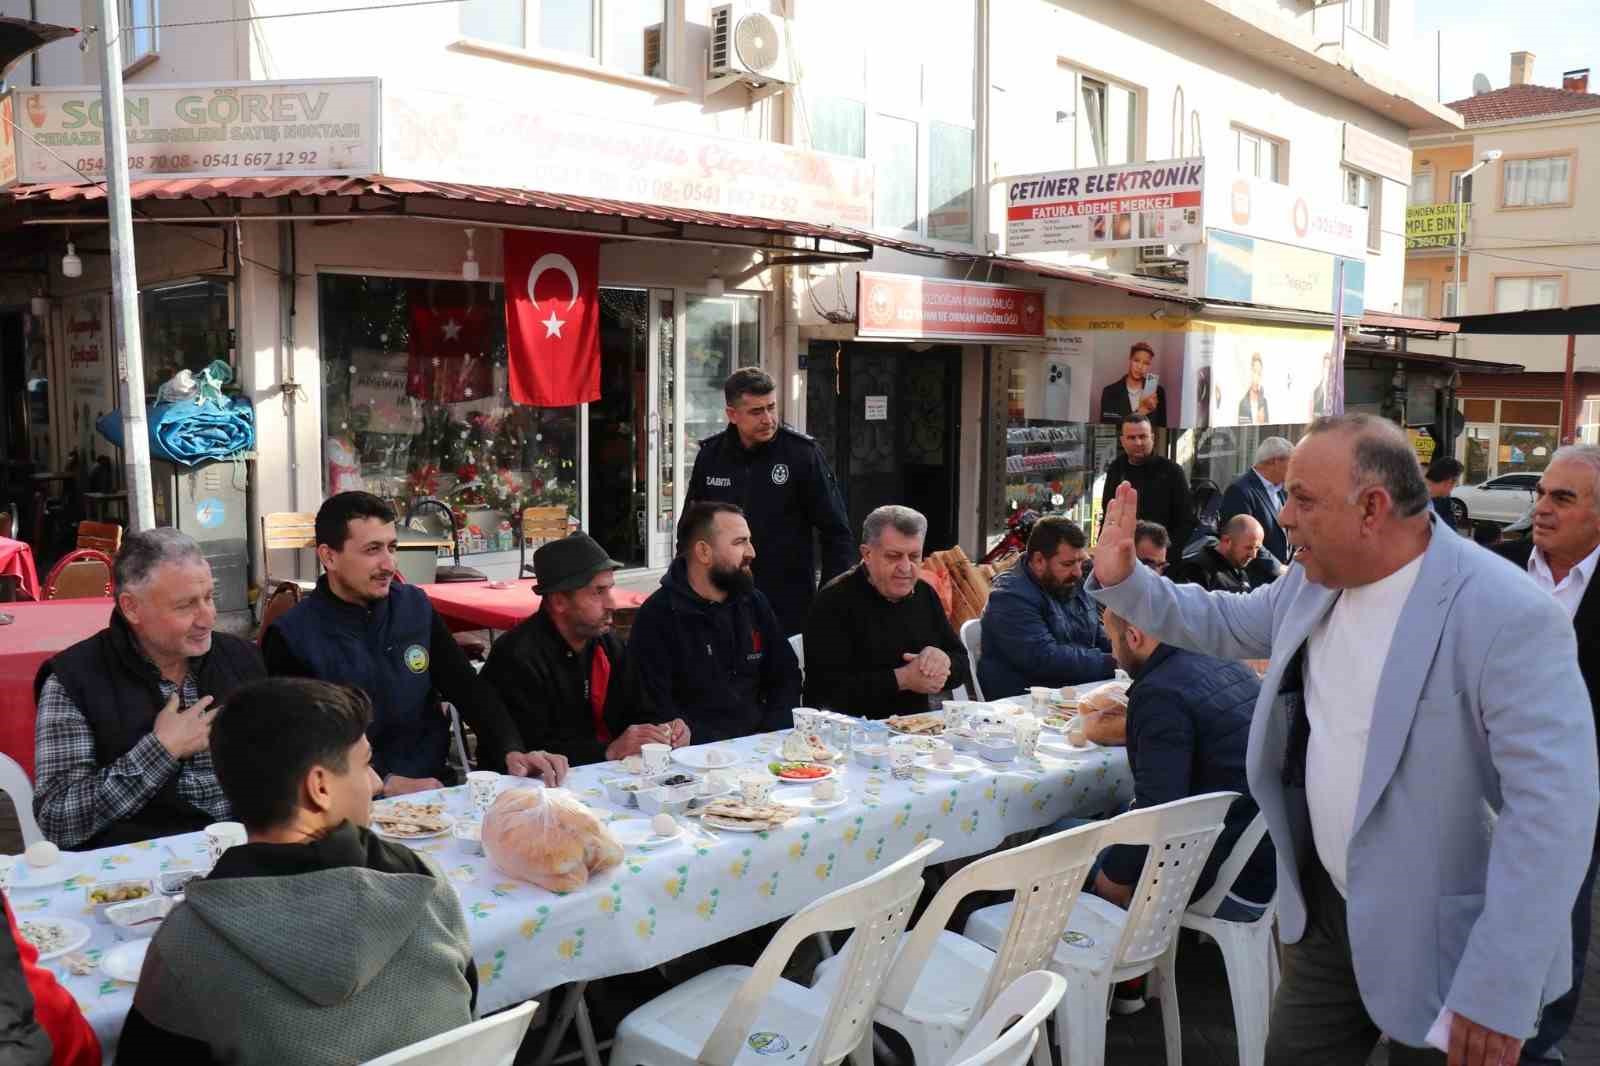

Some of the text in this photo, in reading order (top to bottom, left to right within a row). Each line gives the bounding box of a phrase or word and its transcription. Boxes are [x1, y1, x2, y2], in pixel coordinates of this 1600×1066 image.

[175, 87, 329, 125] GÖREV
[126, 127, 227, 145] LZEMELERİ
[76, 158, 104, 172] 054
[127, 155, 144, 169] 08
[202, 152, 239, 167] 0541
[244, 151, 272, 167] 667
[276, 151, 295, 165] 12
[299, 150, 318, 164] 92
[1085, 161, 1202, 194] ELEKTRONİK
[1031, 192, 1175, 219] FATURA ÖDEME MERKEZİ
[1437, 216, 1464, 232] BİN
[1088, 320, 1125, 330] realme
[706, 476, 732, 487] ZABITA
